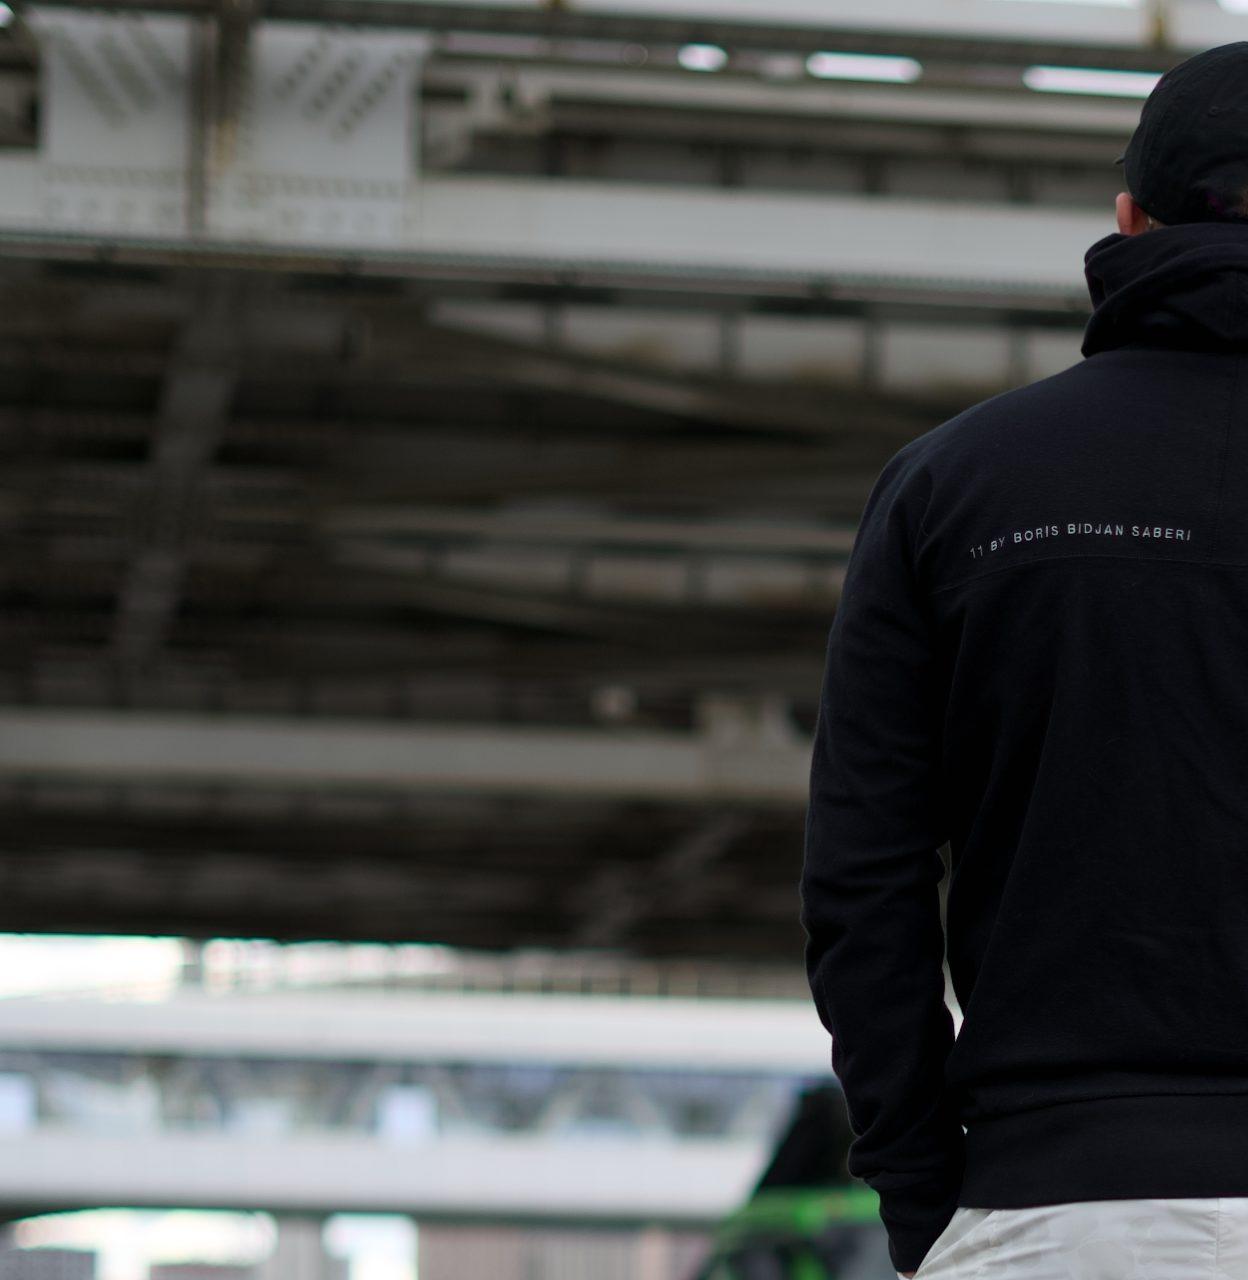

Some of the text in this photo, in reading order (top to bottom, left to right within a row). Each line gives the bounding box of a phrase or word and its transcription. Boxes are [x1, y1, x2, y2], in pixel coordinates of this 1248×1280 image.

[969, 522, 1192, 560] 11 BY BORIS BIDJAN SABERI
